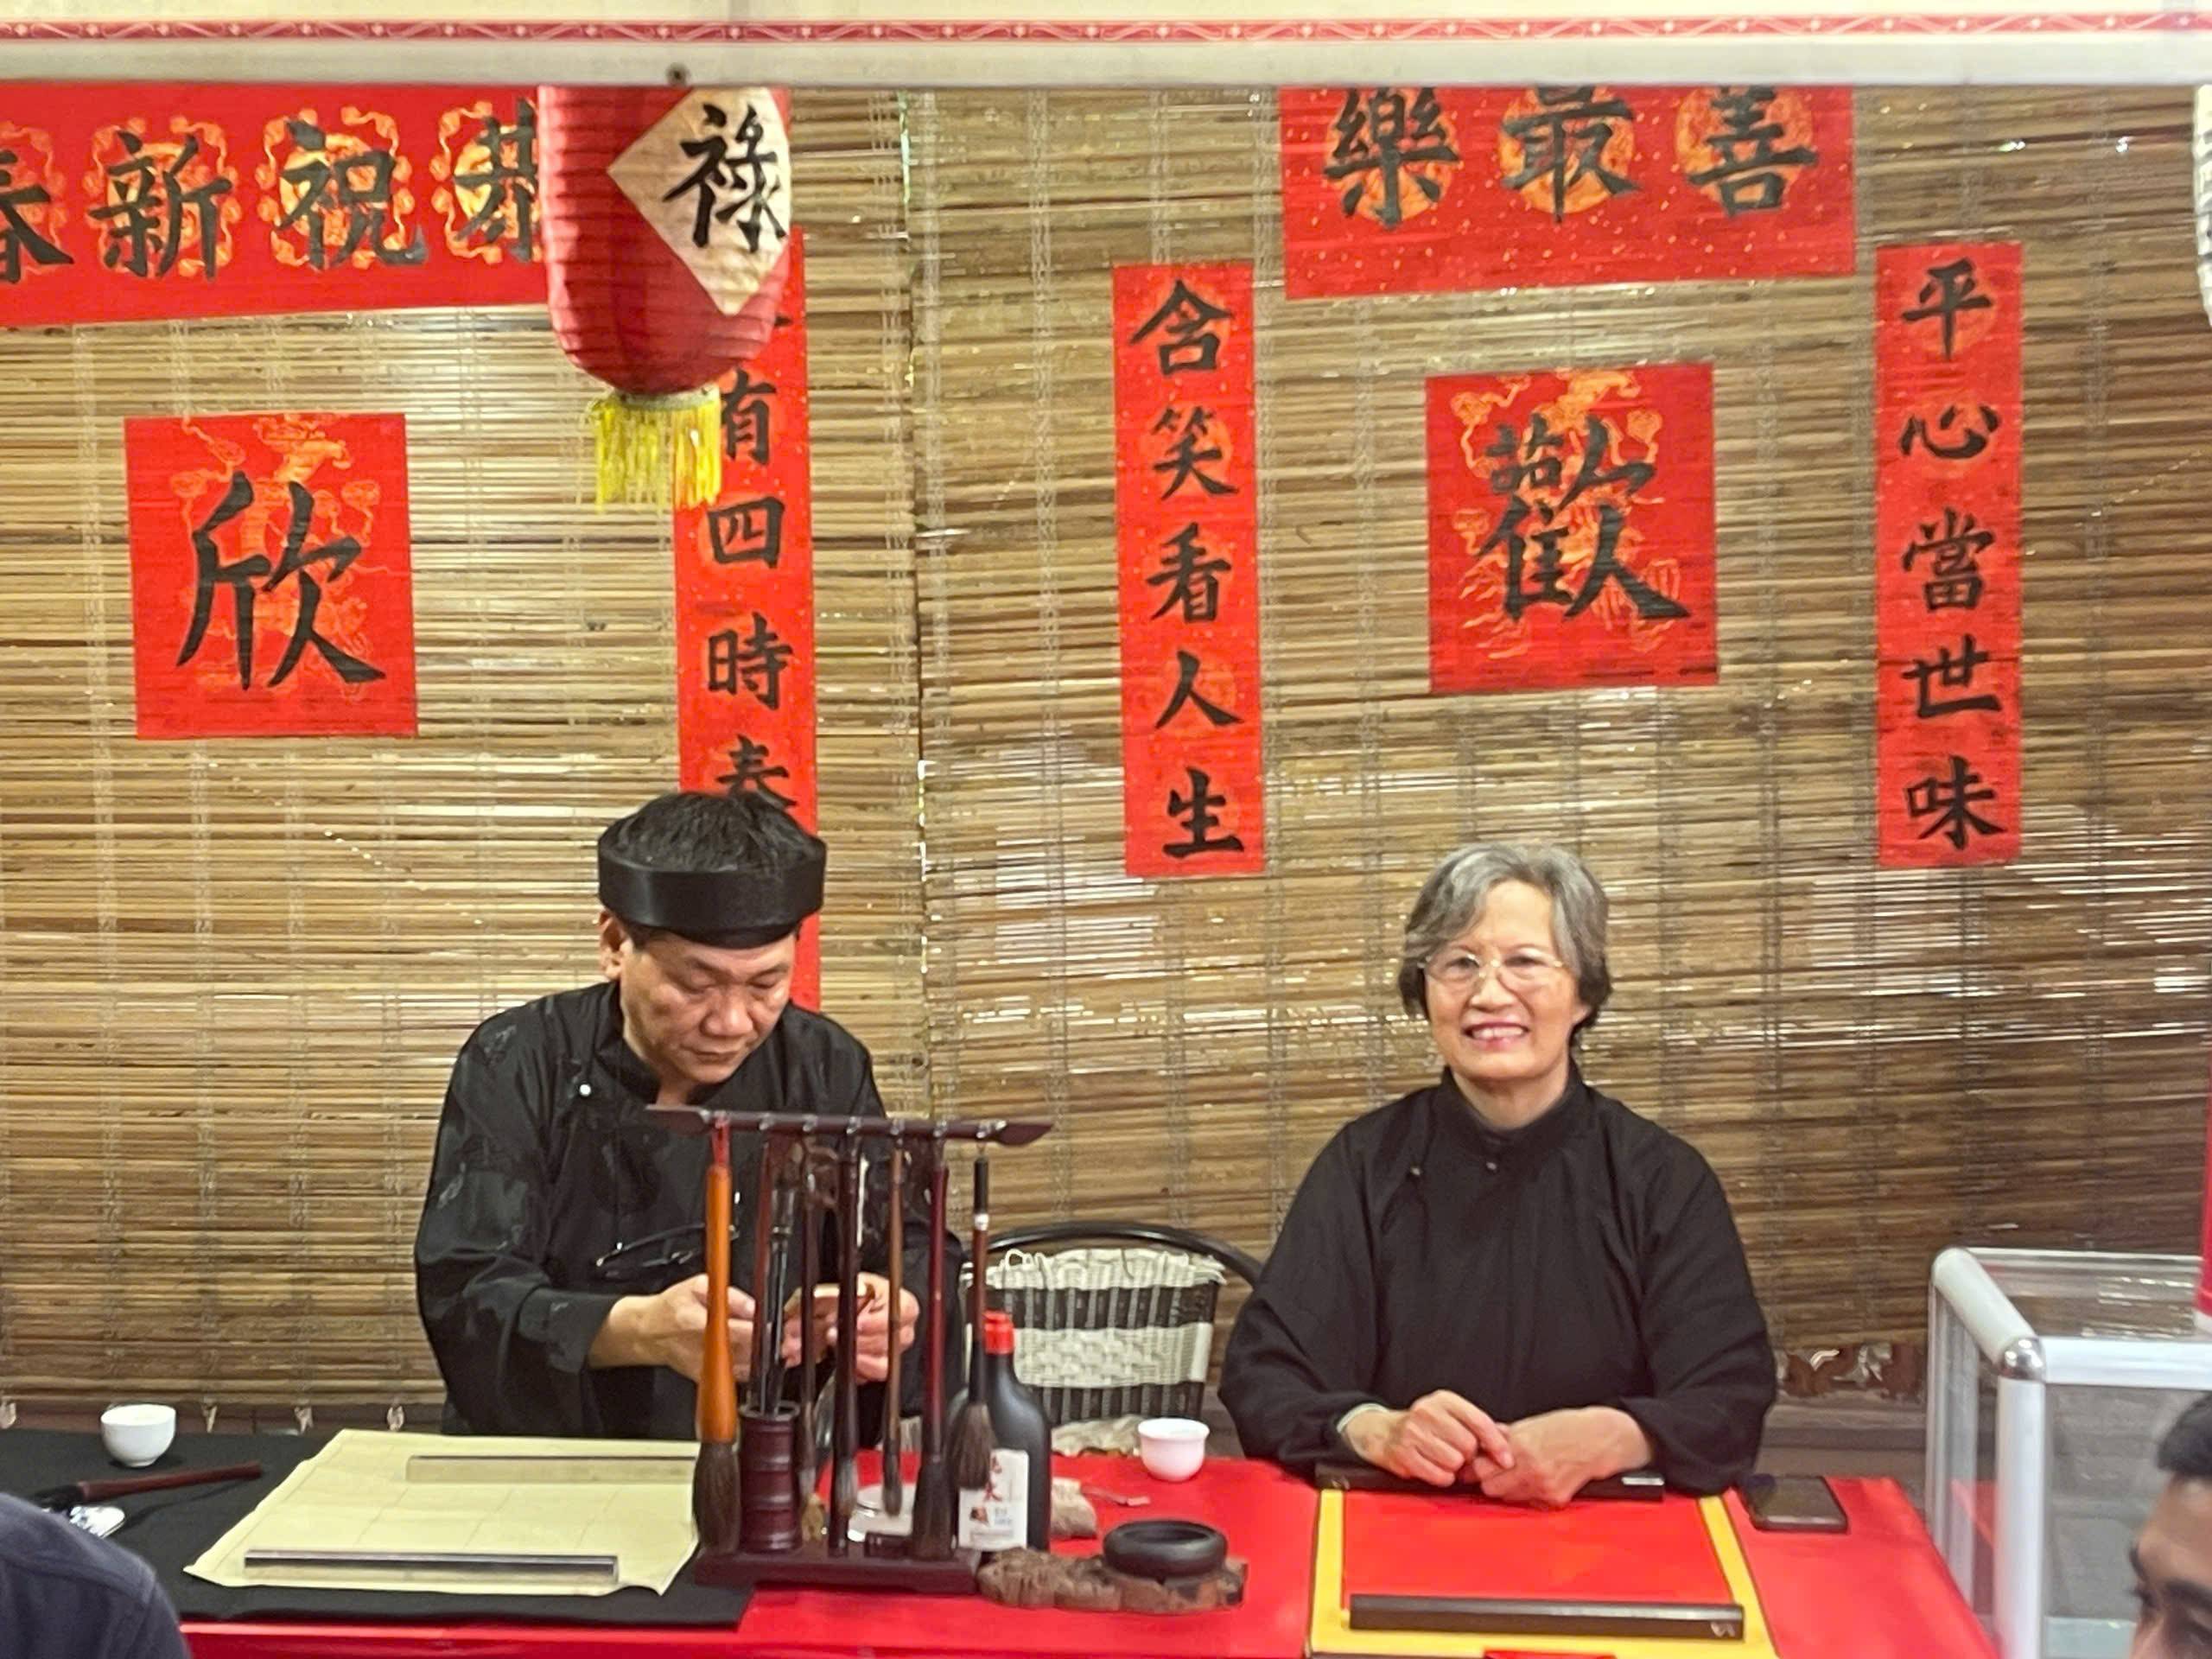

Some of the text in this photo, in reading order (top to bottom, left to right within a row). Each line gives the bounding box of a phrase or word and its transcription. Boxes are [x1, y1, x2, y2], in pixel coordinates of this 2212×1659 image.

[176, 471, 386, 690] 欣
[1129, 279, 1244, 858] 含笑看人生
[1897, 259, 2006, 849] 平心當世味
